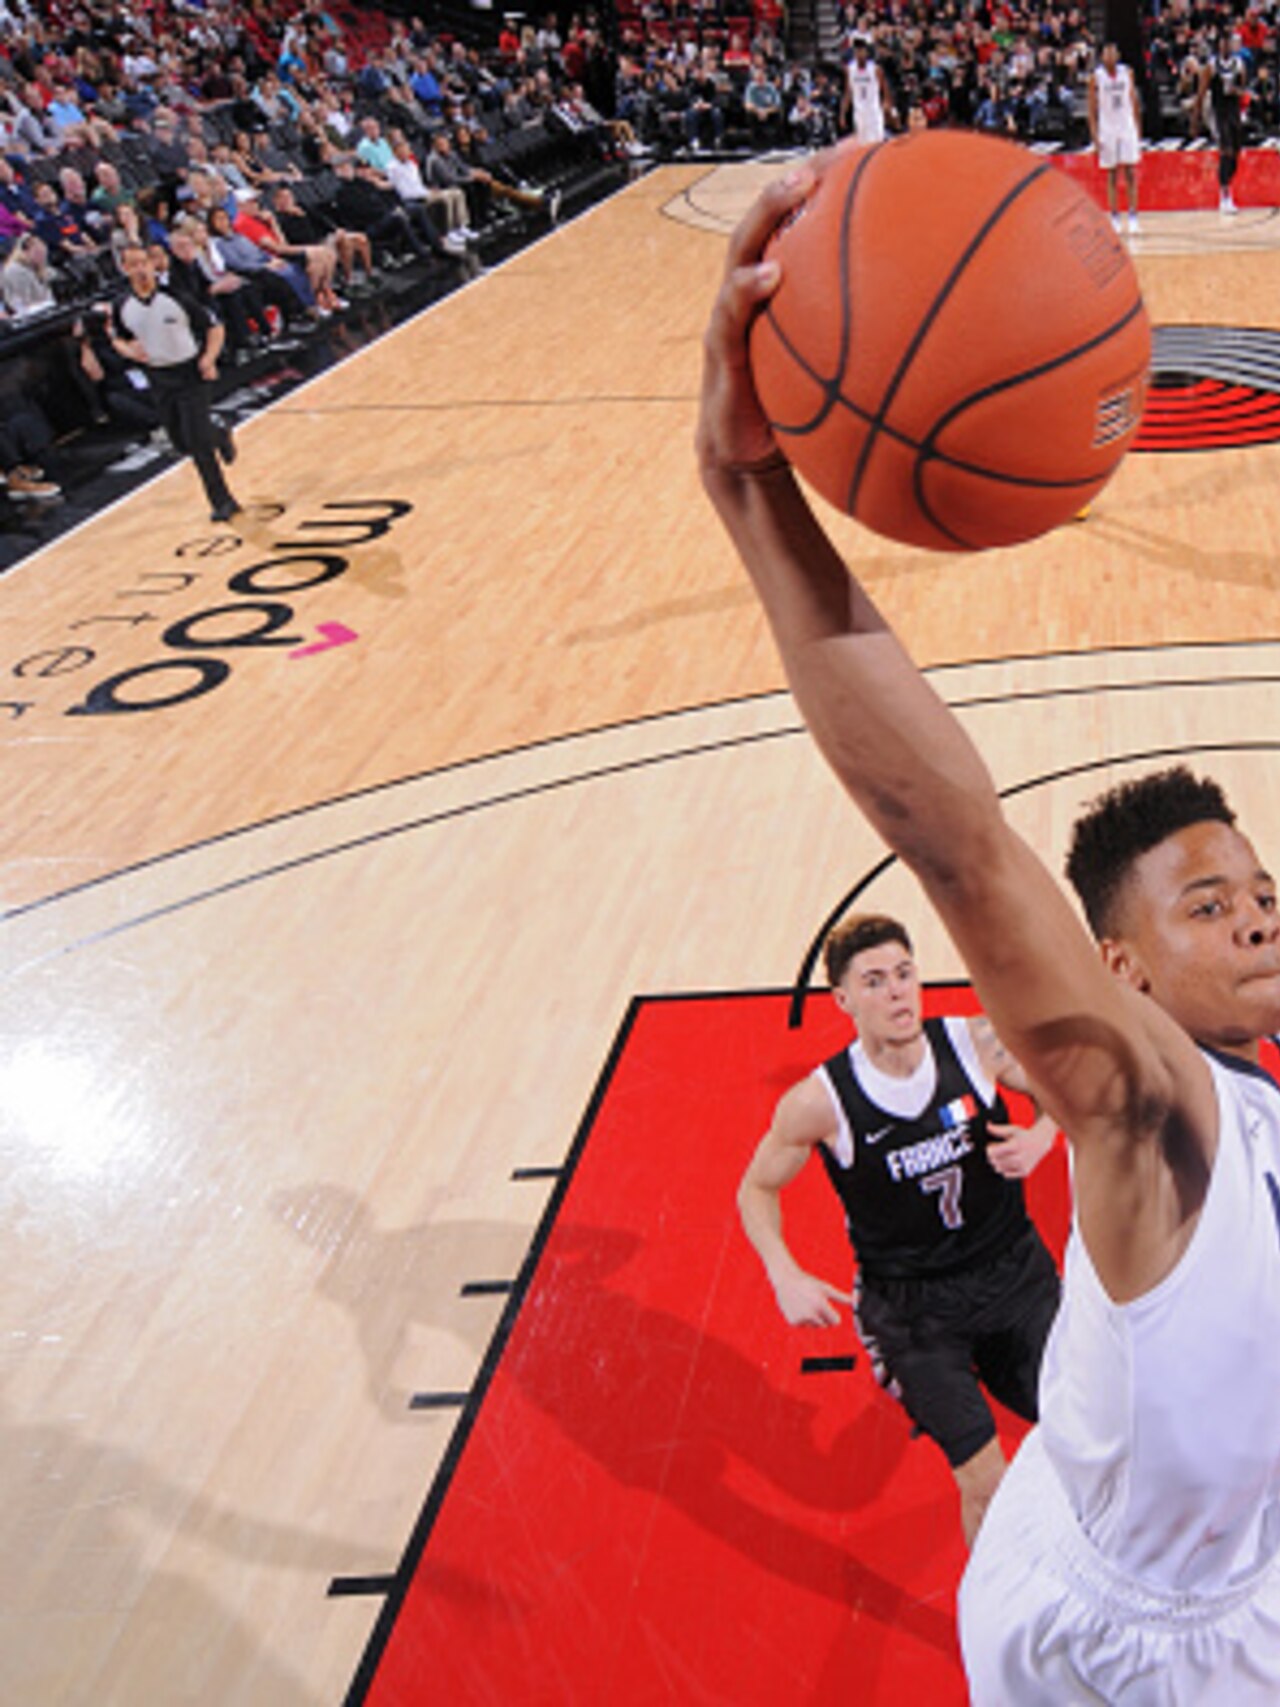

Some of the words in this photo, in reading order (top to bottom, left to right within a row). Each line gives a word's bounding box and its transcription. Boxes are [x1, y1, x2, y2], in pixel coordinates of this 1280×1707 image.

[64, 500, 413, 716] moda
[886, 1123, 974, 1181] FRANCE
[919, 1164, 964, 1230] 7
